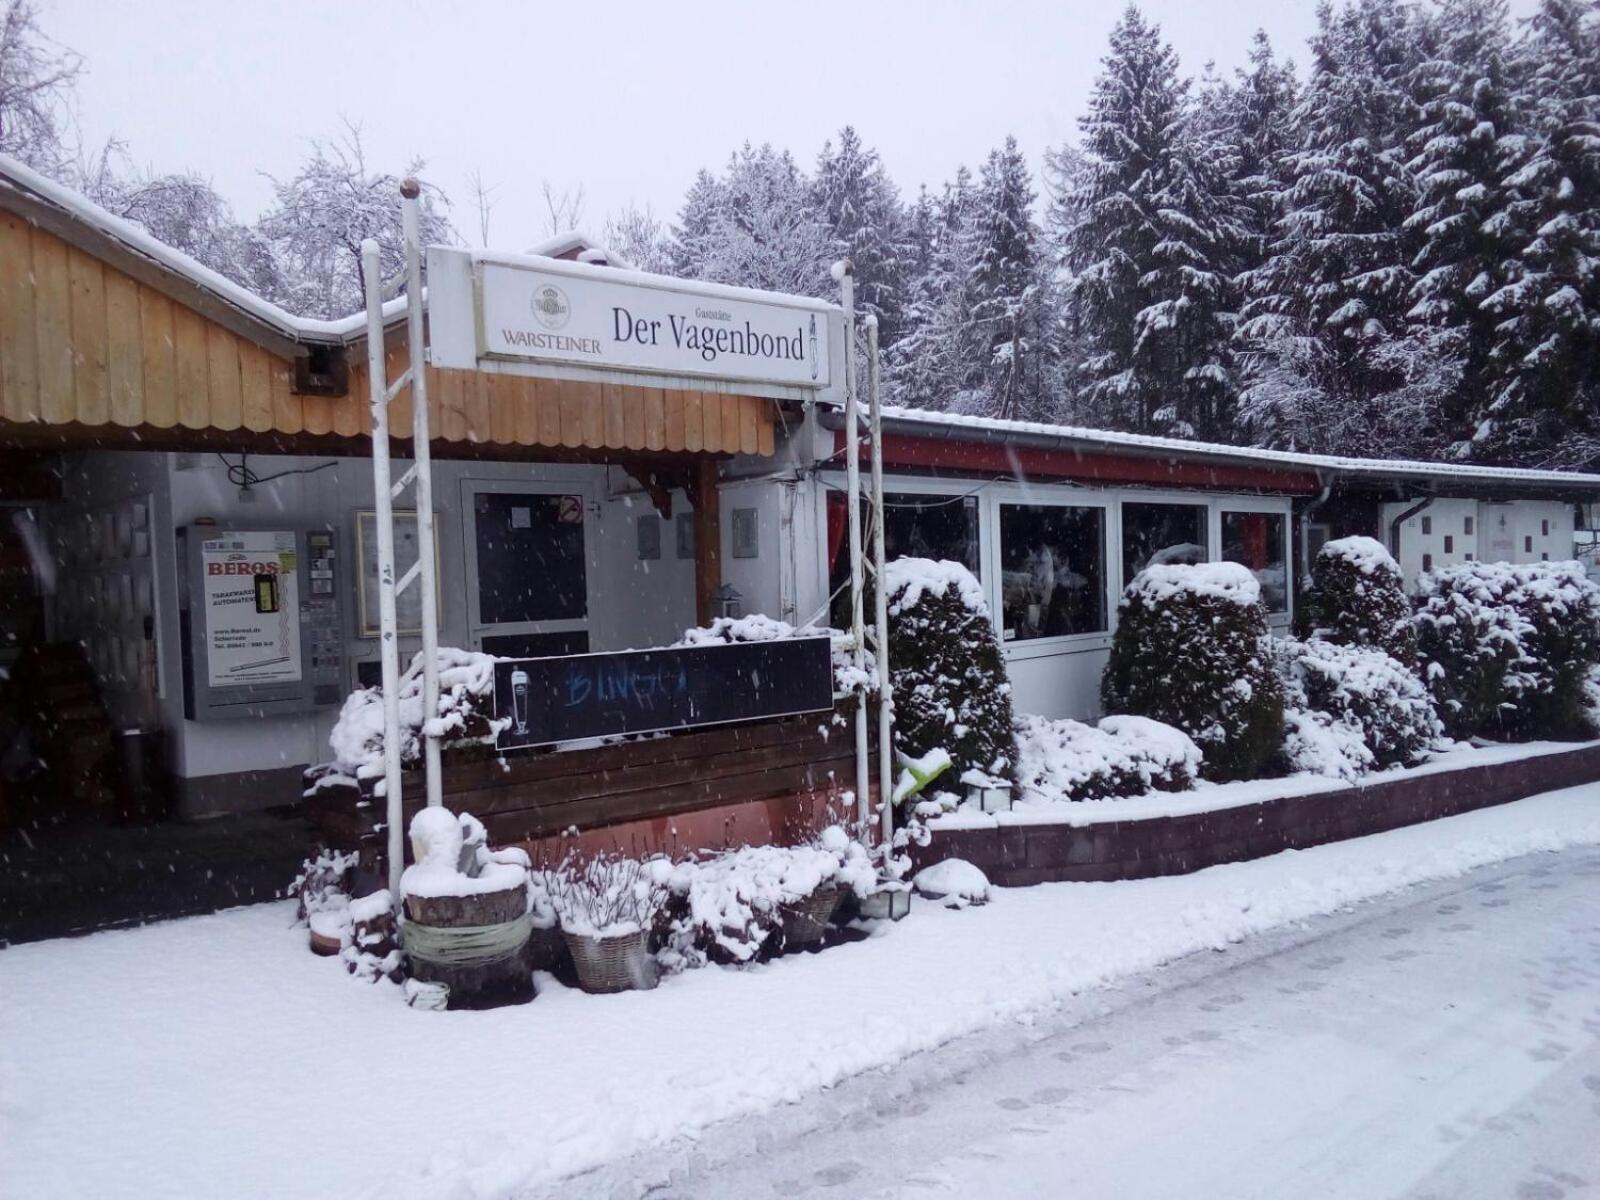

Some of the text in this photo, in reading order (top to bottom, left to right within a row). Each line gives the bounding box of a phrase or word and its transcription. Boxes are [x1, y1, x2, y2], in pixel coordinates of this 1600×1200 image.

[502, 328, 602, 355] WARSTEINER
[612, 307, 805, 361] Der Vagenbond
[207, 561, 279, 576] BEROS
